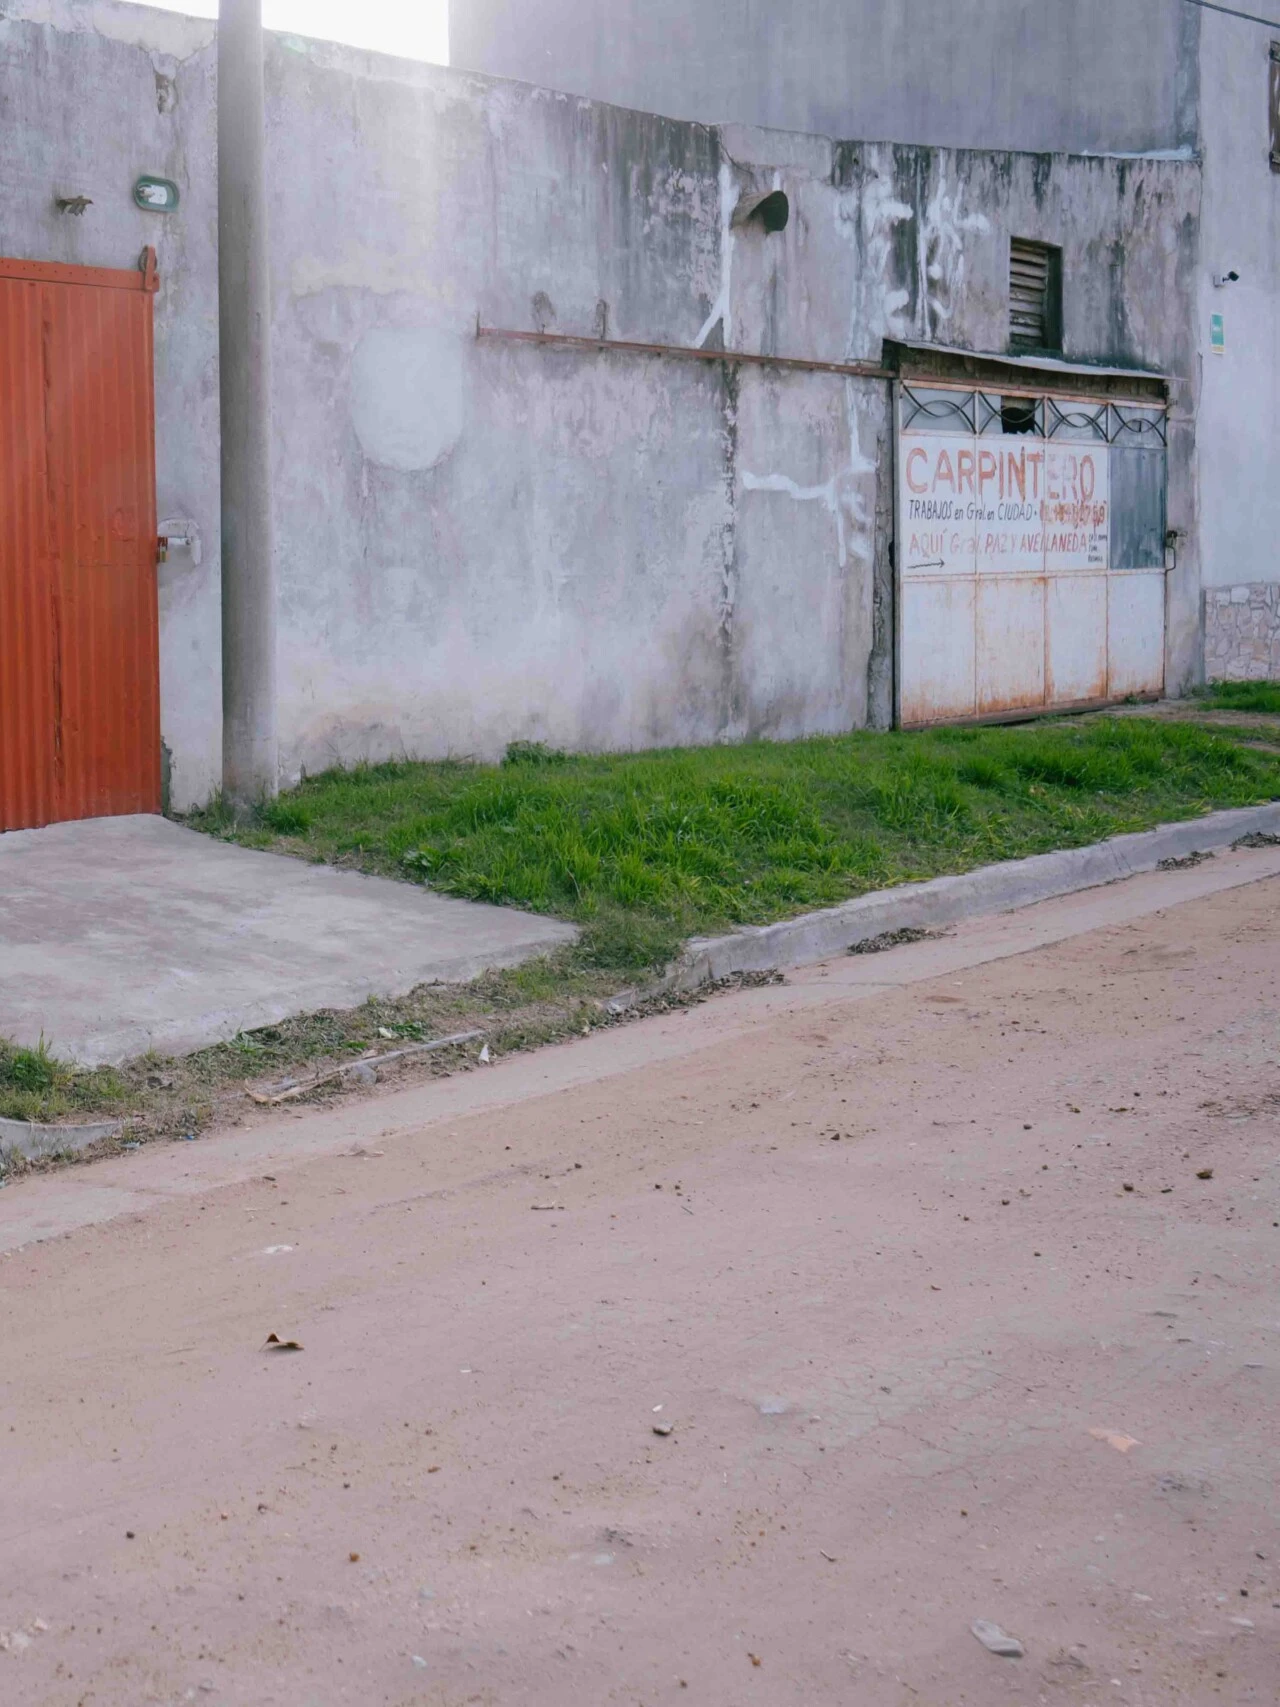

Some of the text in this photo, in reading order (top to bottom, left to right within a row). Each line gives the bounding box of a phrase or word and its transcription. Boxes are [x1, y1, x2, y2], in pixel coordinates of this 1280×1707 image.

[905, 446, 1095, 502] CARPINTERO
[909, 499, 953, 520] TRABAJOS
[954, 508, 964, 520] en
[997, 503, 1033, 520] CIUDAD
[1020, 531, 1088, 553] AVELLANEDA
